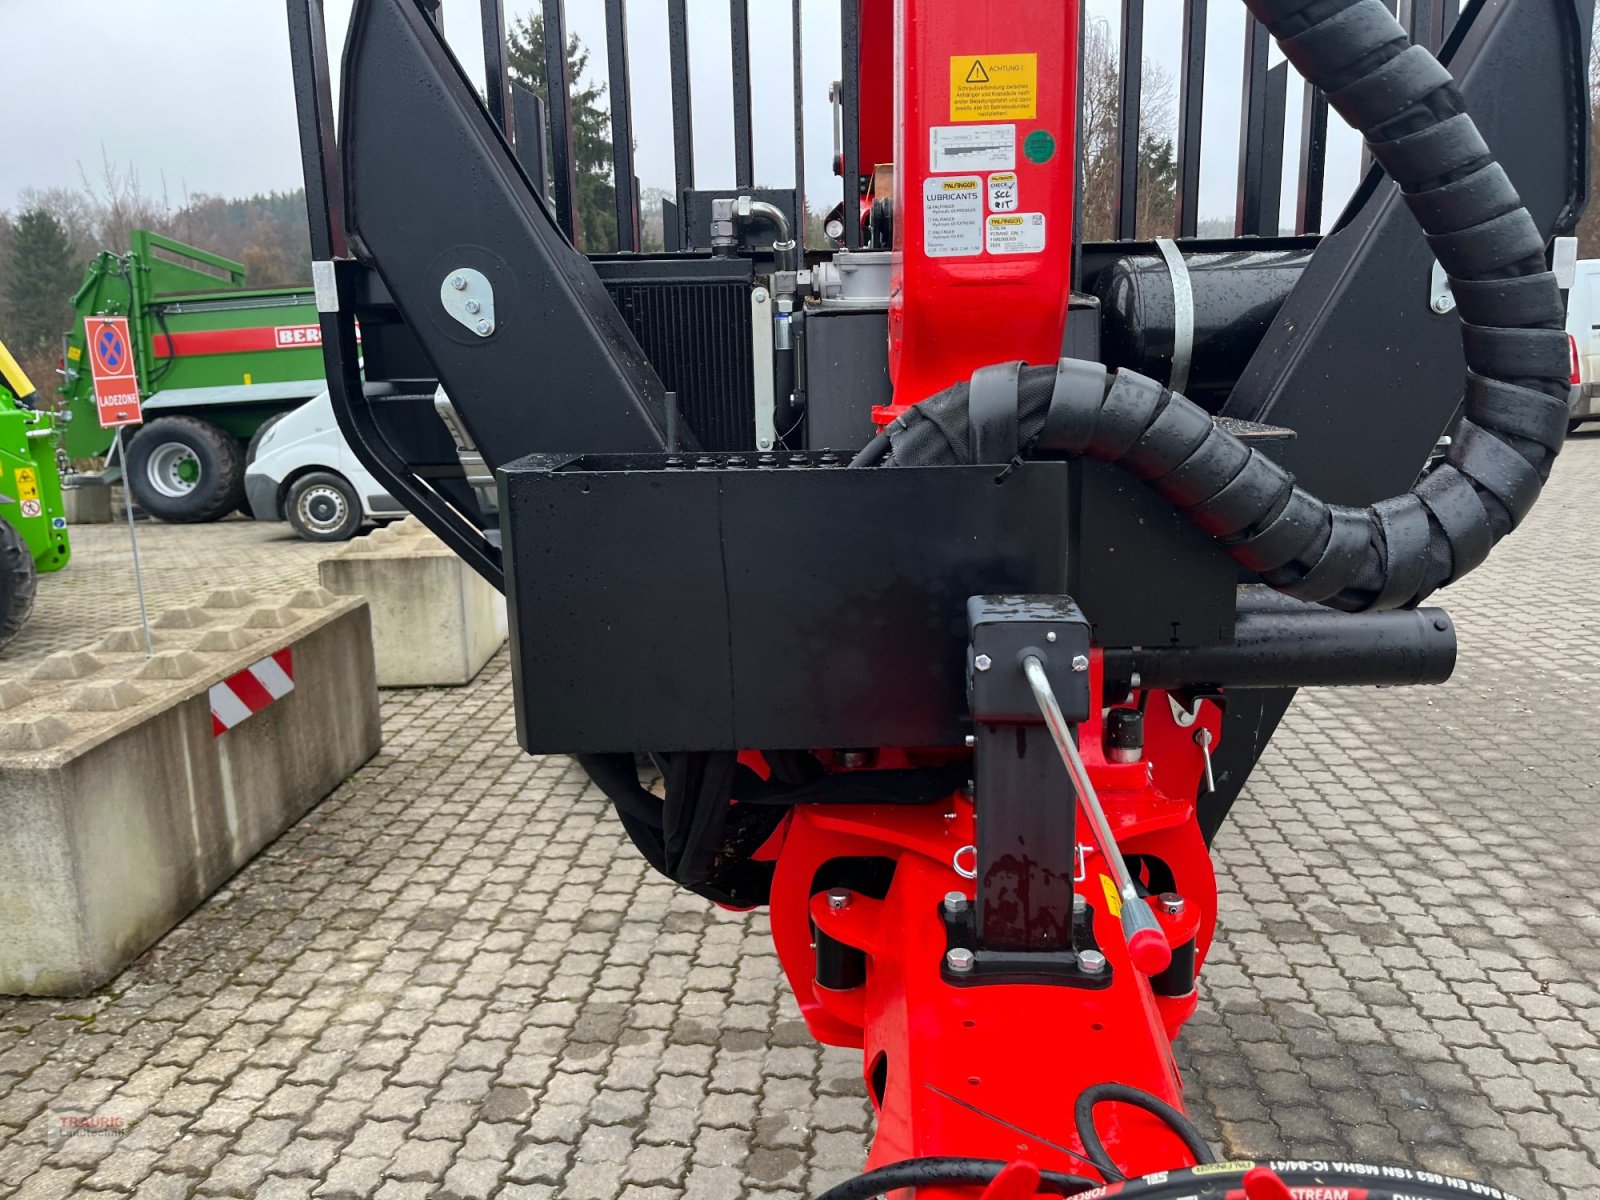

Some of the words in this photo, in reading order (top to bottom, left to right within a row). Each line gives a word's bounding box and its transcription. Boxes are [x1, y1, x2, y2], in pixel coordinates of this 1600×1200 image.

[943, 181, 976, 189] PALFINGER
[926, 192, 978, 201] LUBRICANTS
[99, 393, 137, 407] LADEZONE
[1269, 1160, 1329, 1172] IC-84/41
[1331, 1162, 1380, 1176] MSHA
[1382, 1166, 1413, 1180] 1SN
[1416, 1171, 1444, 1185] 853
[1446, 1176, 1468, 1190] EN
[1470, 1181, 1503, 1199] BAR
